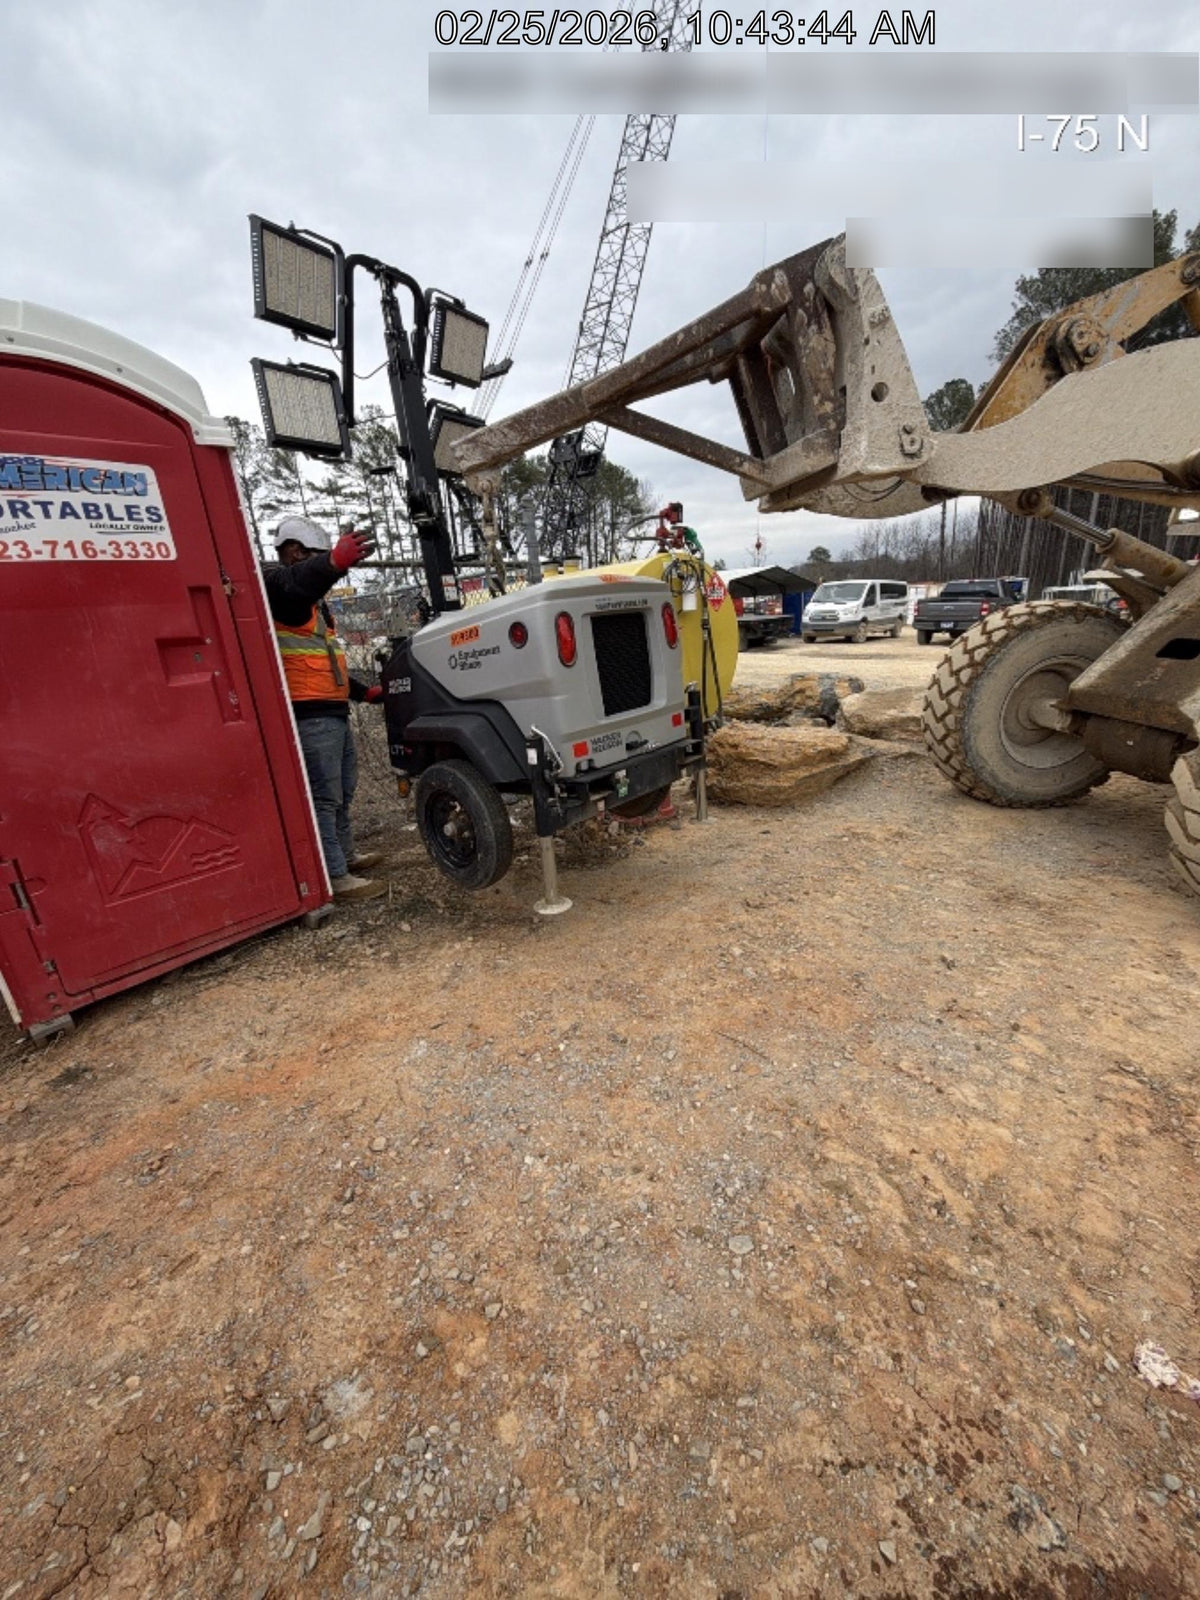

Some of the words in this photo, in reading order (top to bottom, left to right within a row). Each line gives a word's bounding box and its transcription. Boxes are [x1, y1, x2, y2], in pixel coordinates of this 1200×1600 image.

[0, 498, 163, 523] RTABLES
[89, 522, 131, 531] LOCALLY
[132, 523, 166, 532] OWNED
[0, 539, 171, 560] 23-716-3330
